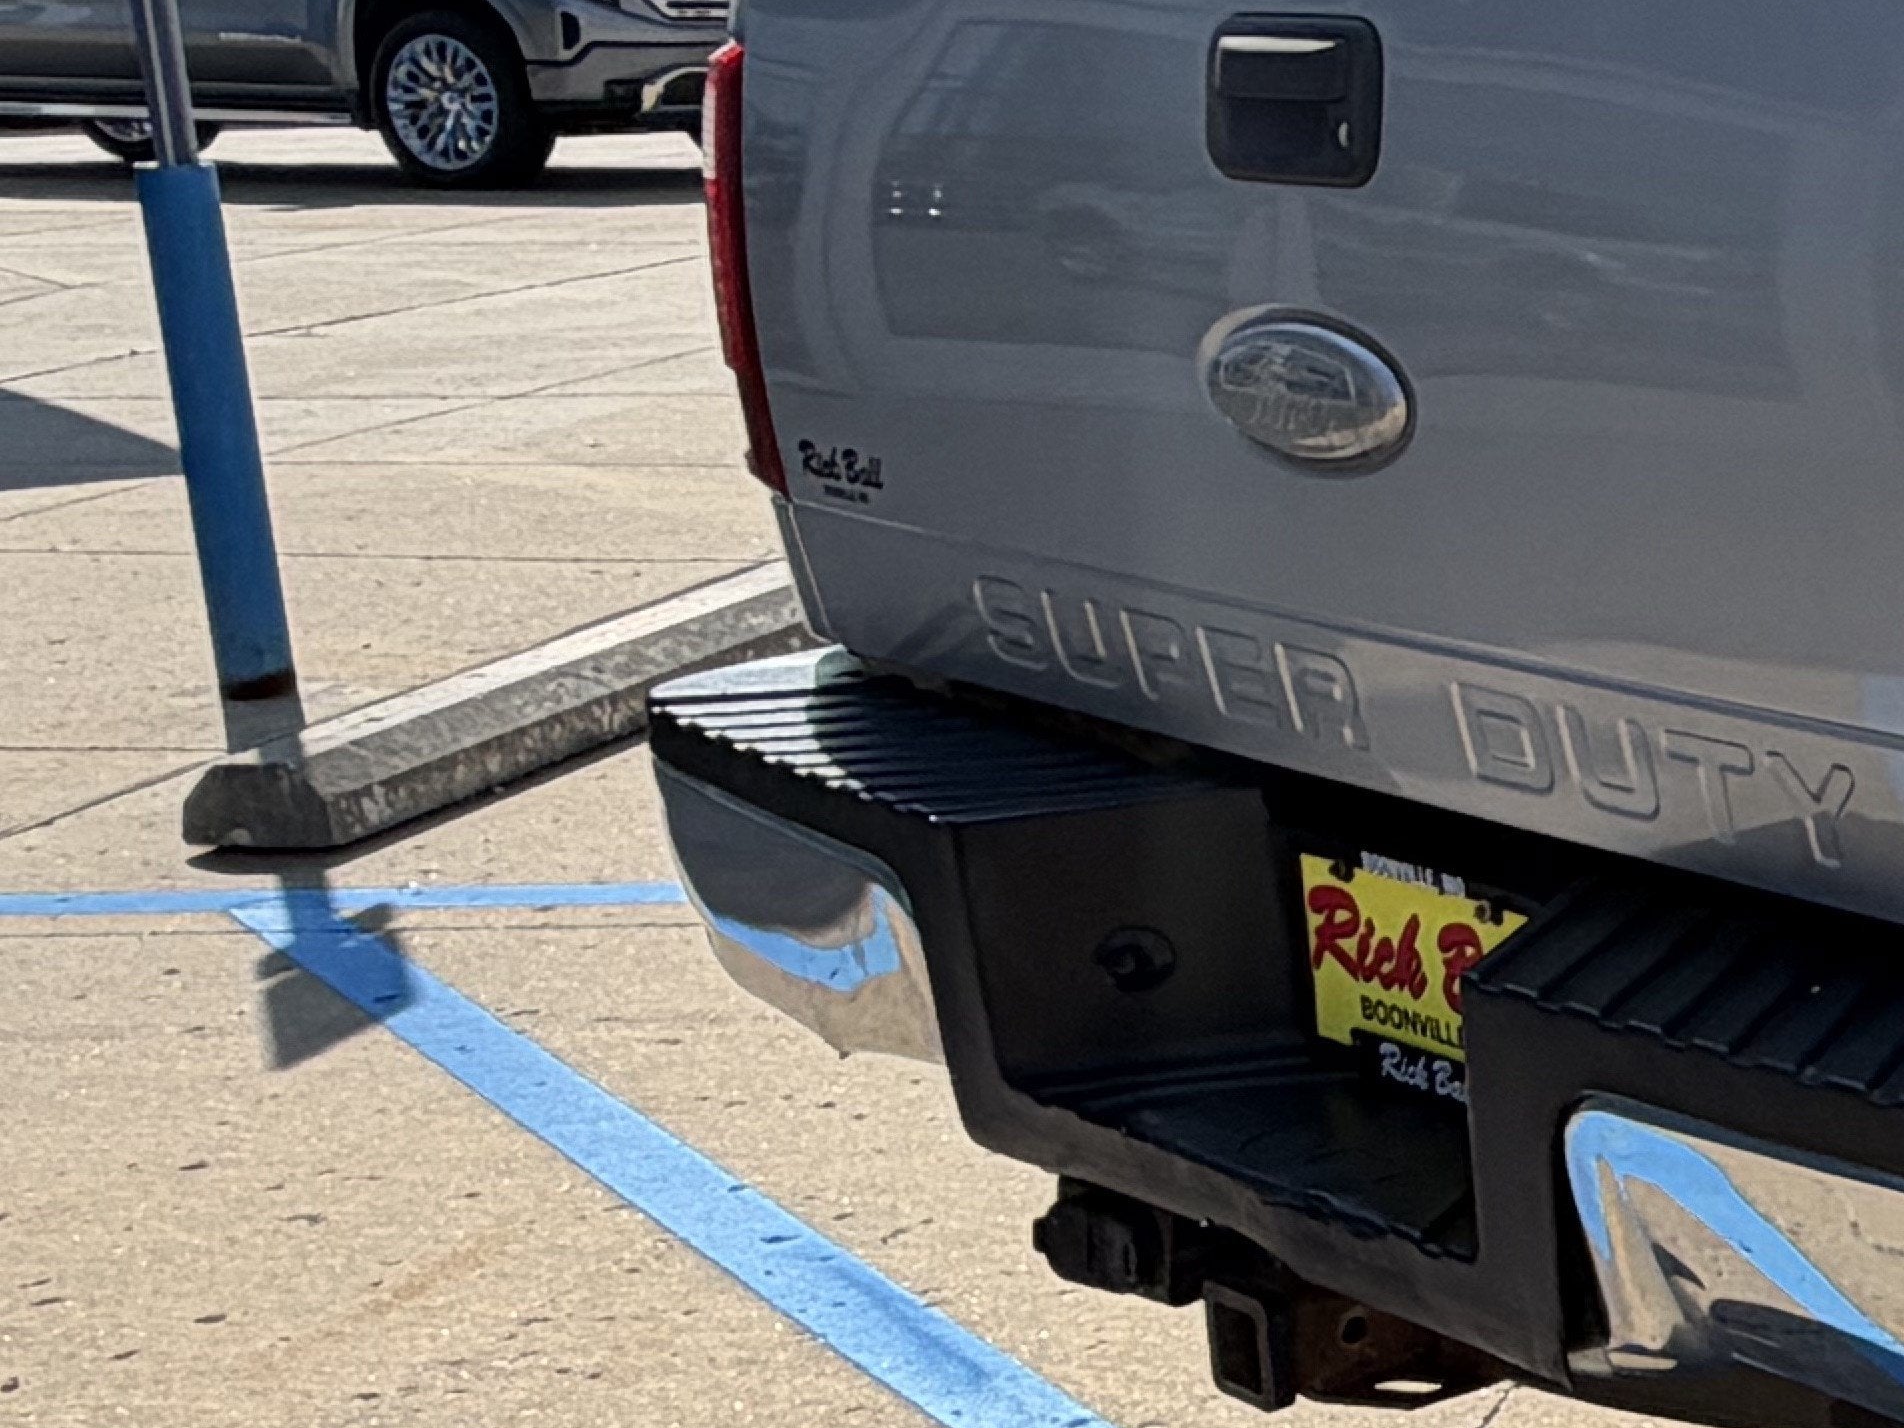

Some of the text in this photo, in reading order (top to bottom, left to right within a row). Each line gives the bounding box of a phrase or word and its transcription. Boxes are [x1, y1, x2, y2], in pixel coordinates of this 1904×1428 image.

[972, 573, 1856, 869] SUPER DUTY
[1308, 884, 1429, 1002] Rick
[1379, 1042, 1429, 1091] Rick
